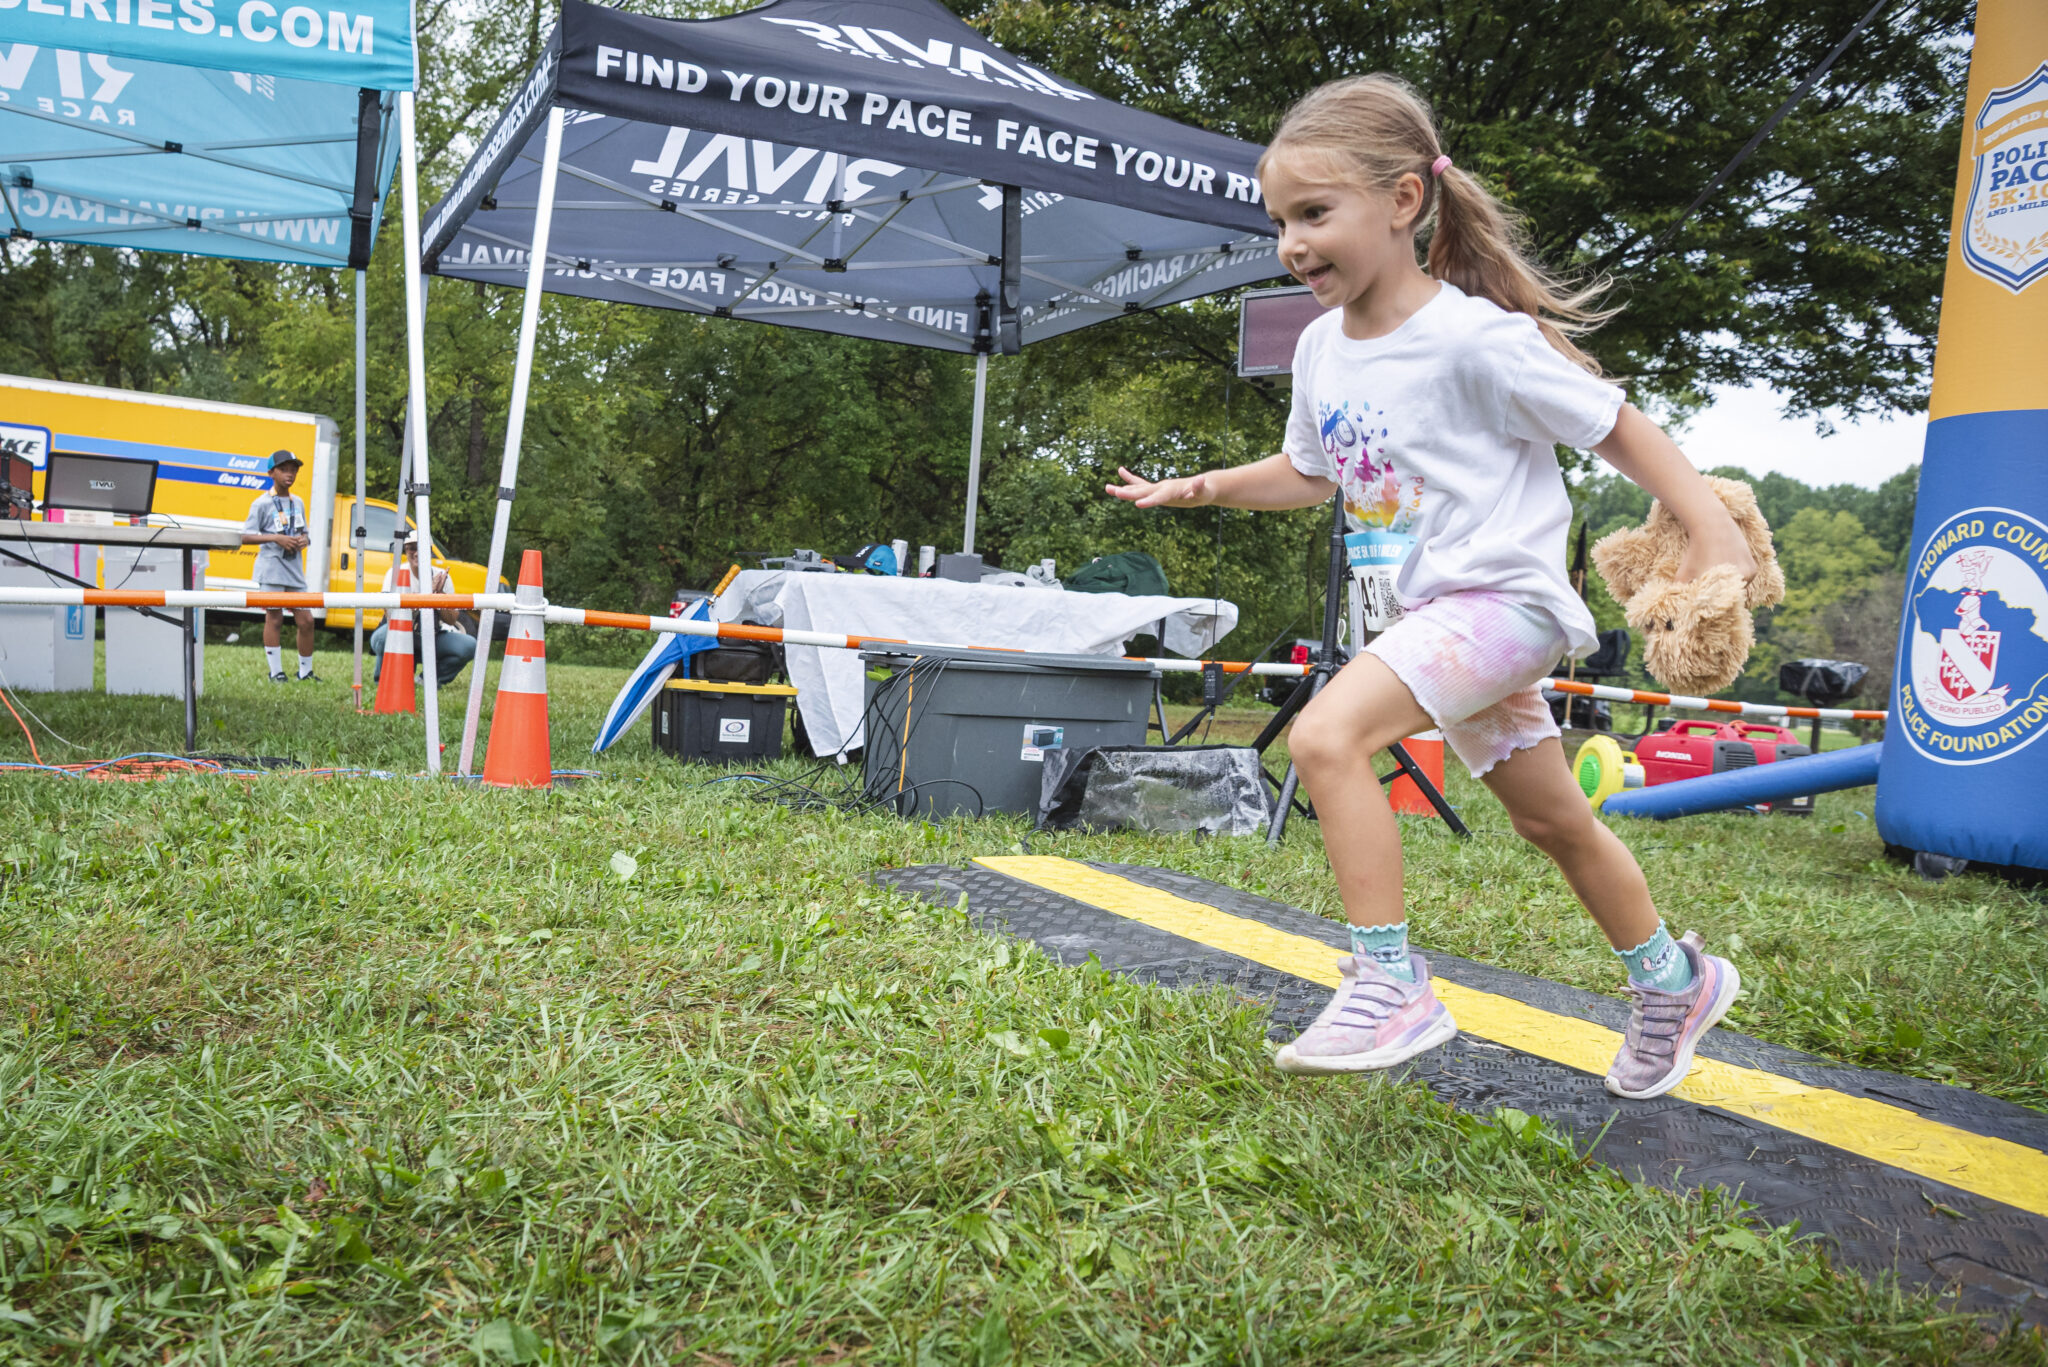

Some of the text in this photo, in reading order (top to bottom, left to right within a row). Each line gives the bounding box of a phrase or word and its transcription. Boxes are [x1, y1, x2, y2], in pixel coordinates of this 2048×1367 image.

[597, 45, 708, 94] FIND
[721, 69, 848, 121] YOUR
[861, 92, 982, 146] PACE.
[996, 119, 1099, 170] FACE
[1111, 142, 1214, 195] YOUR
[218, 472, 266, 490] One Way
[228, 456, 260, 470] Local
[1919, 519, 2048, 579] HOWARD COUN
[1901, 684, 2048, 753] POLICE FOUNDATION
